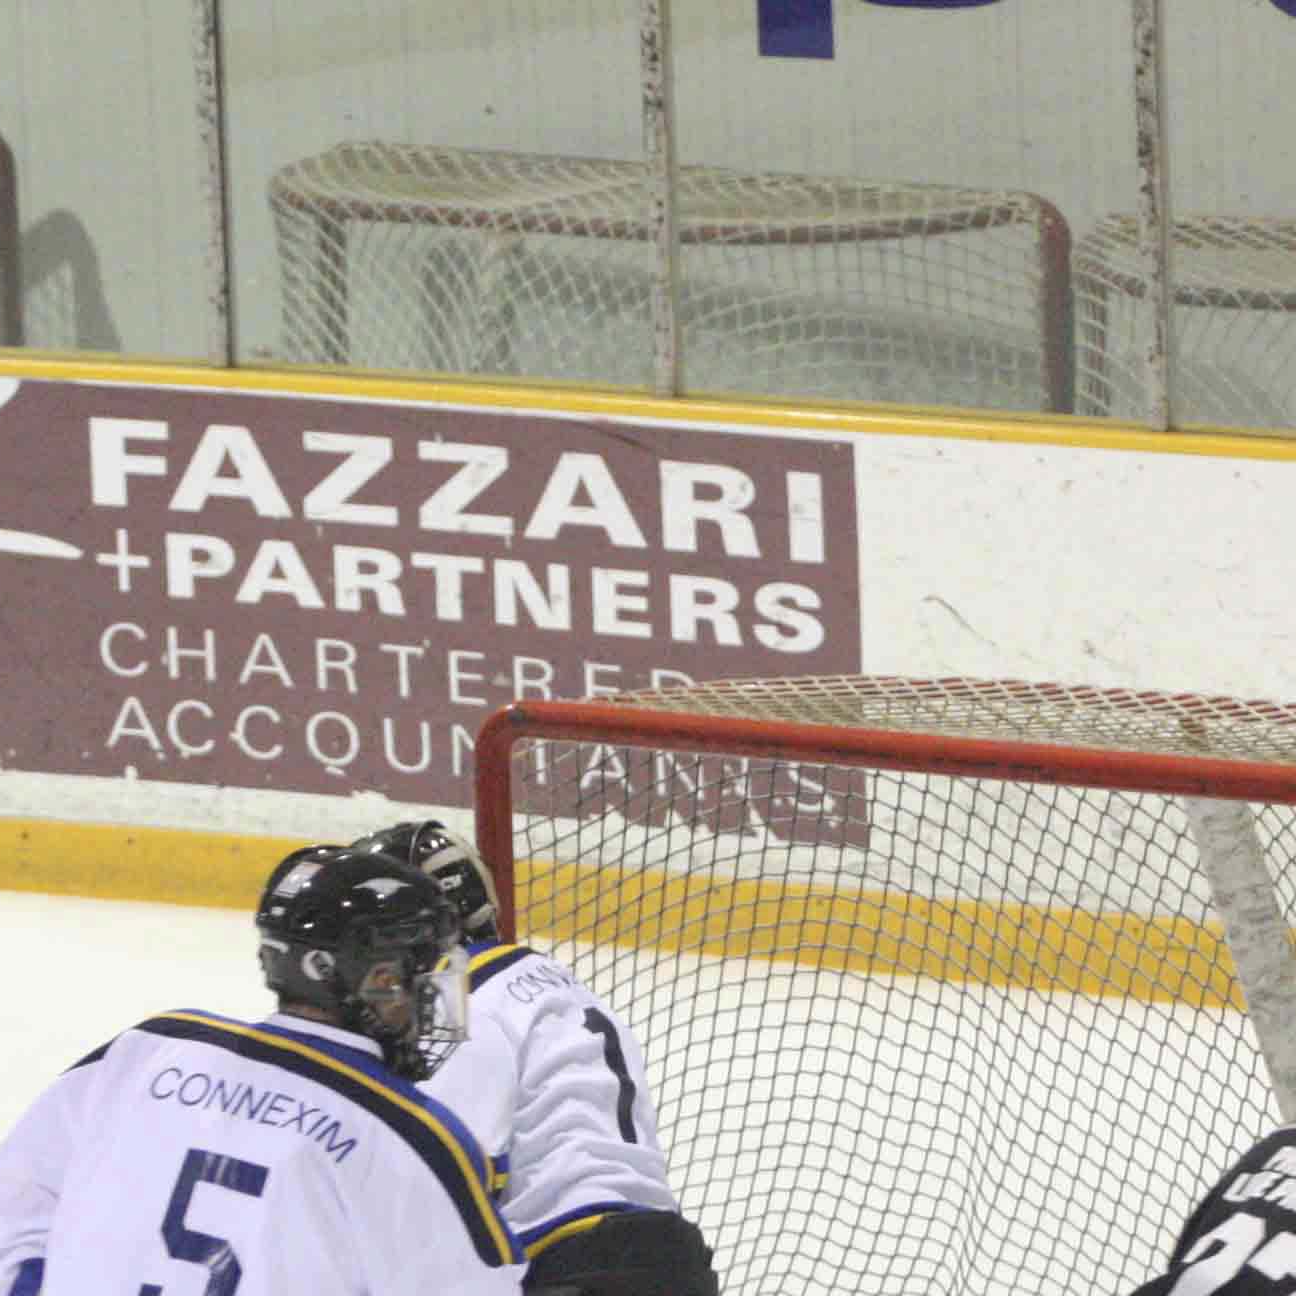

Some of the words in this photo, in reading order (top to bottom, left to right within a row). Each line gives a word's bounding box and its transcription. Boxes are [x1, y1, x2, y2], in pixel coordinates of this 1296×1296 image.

[88, 417, 826, 564] FAZZARI
[149, 1066, 359, 1164] CONNEXIM
[582, 1007, 638, 1145] 1
